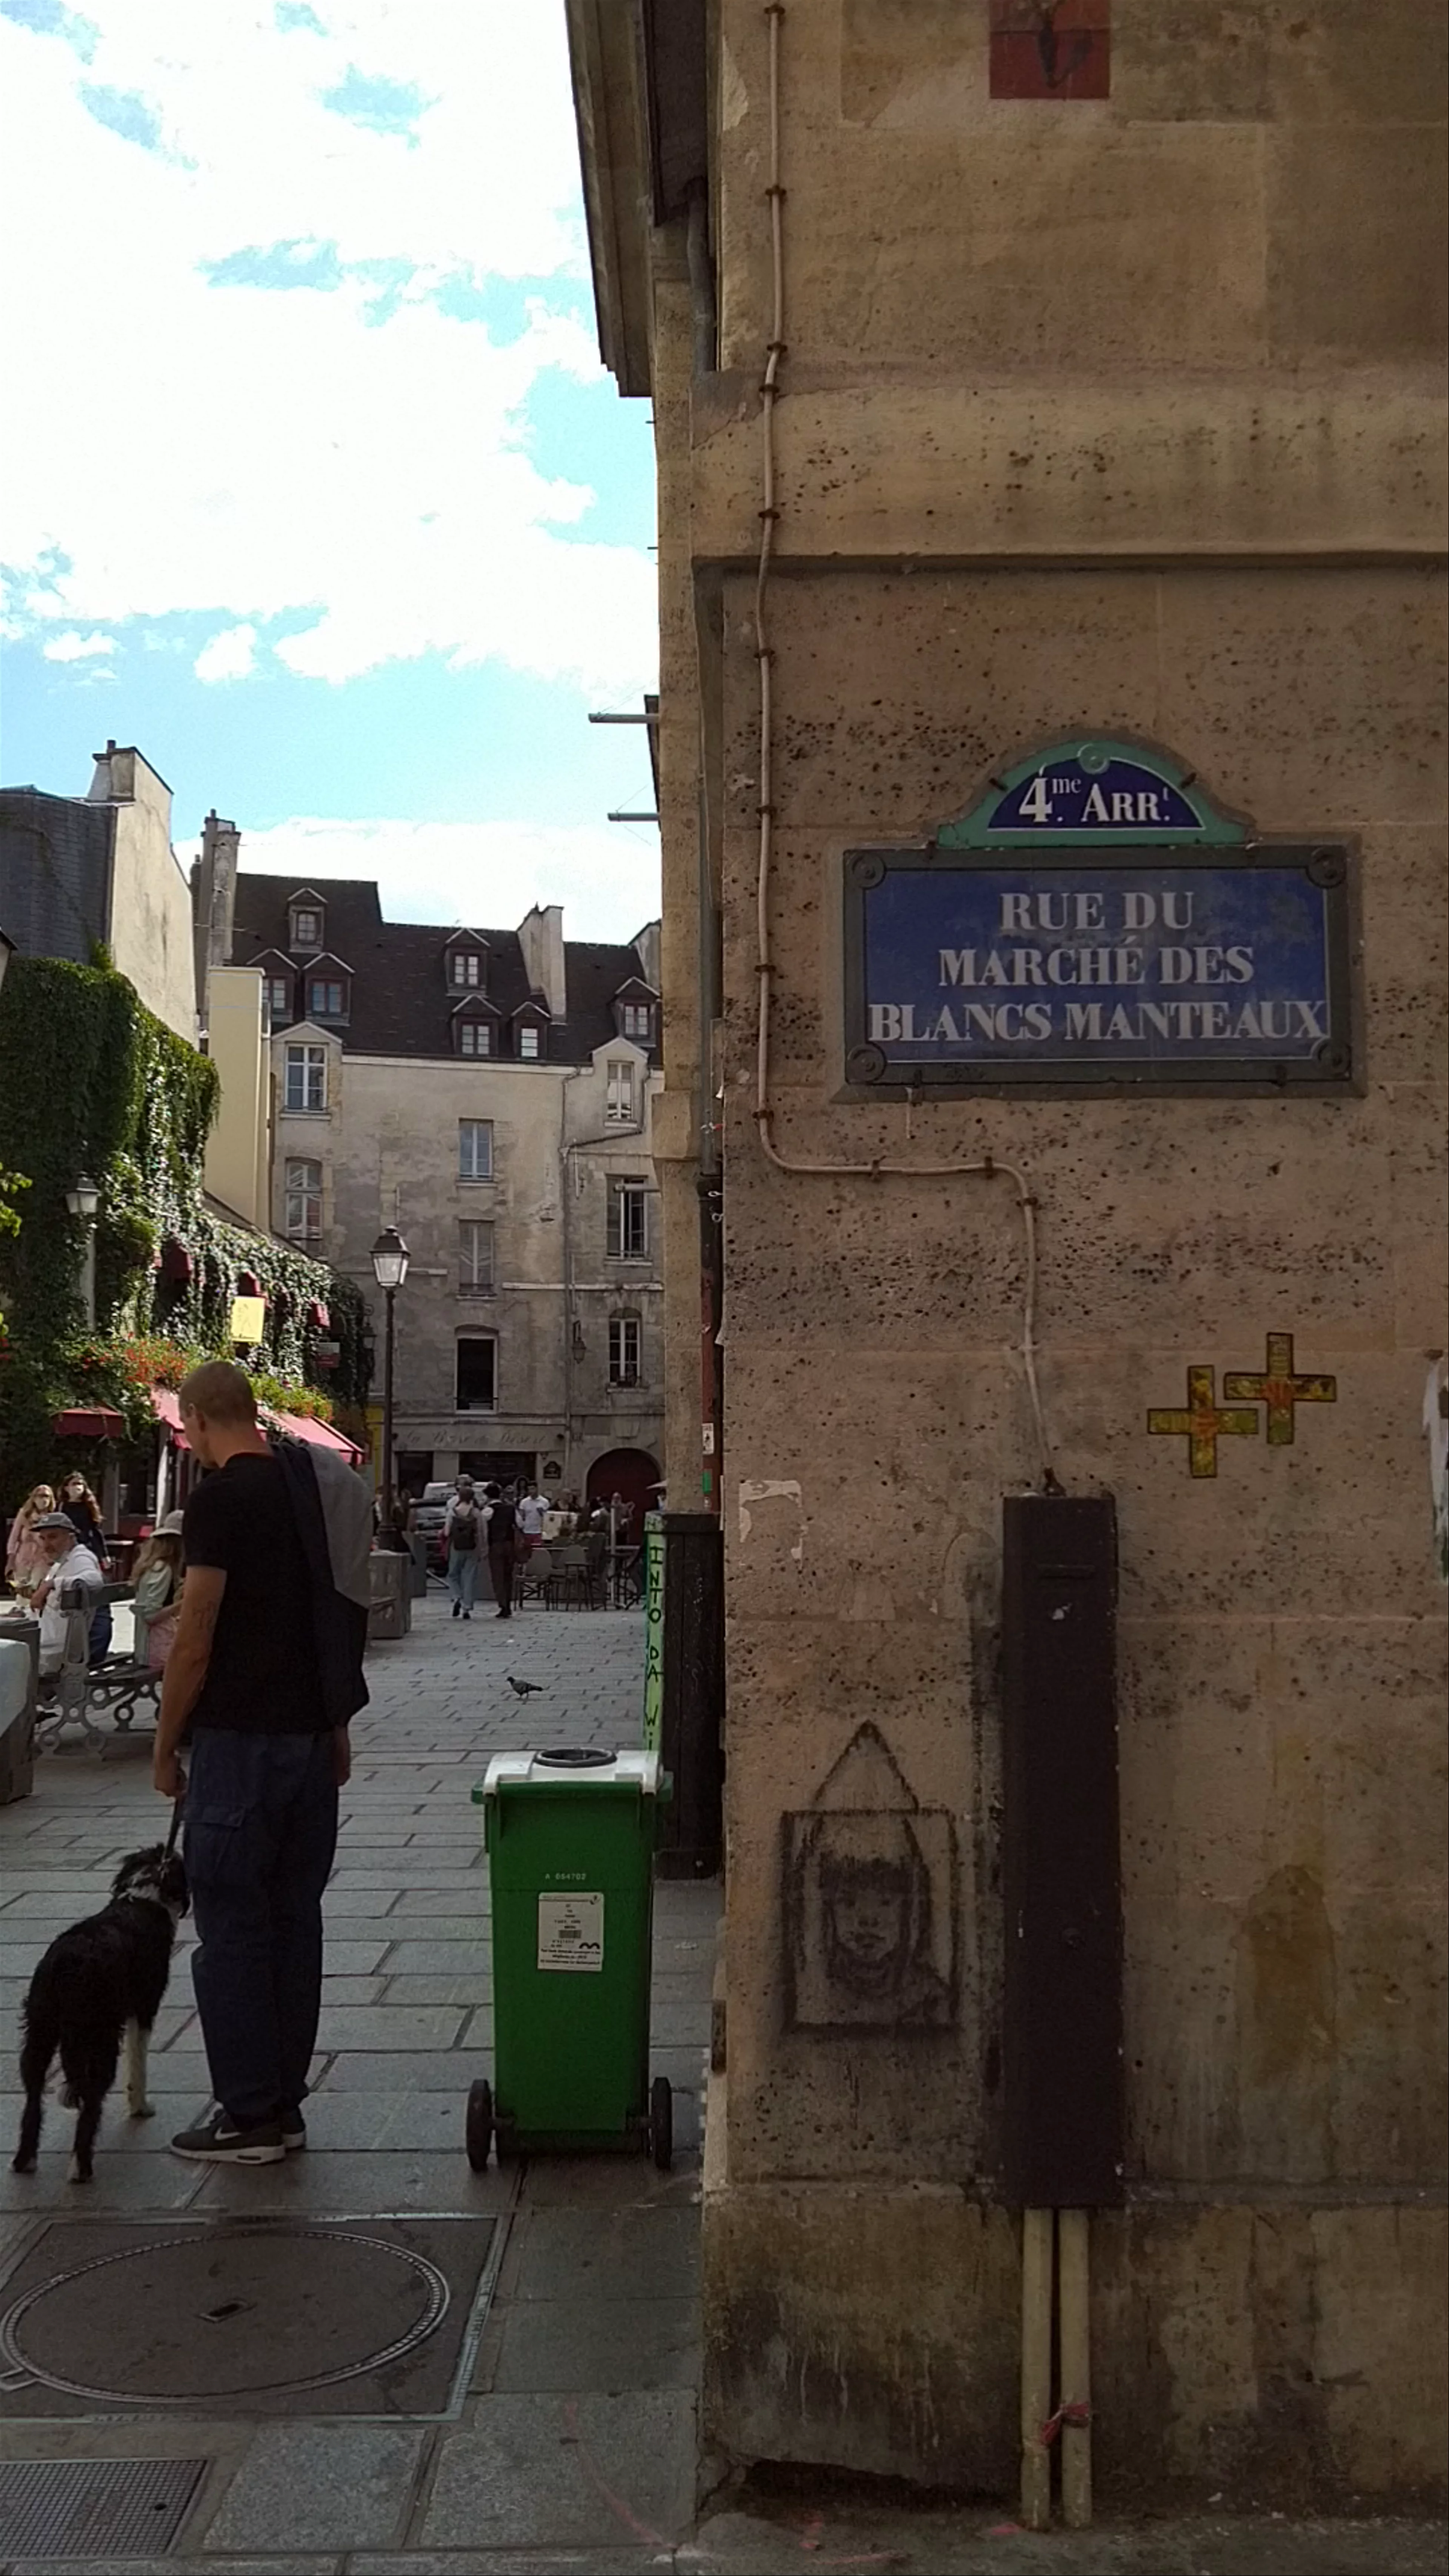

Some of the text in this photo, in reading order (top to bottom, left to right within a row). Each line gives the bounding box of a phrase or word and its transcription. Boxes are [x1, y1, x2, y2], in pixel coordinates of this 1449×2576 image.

[1000, 891, 1194, 930] RUE DU
[938, 935, 1255, 986] MARCHÉ DES
[868, 1000, 1330, 1042] BLANCS MANTEAUX
[648, 1546, 664, 1624] INTO
[647, 1645, 664, 1683] DA
